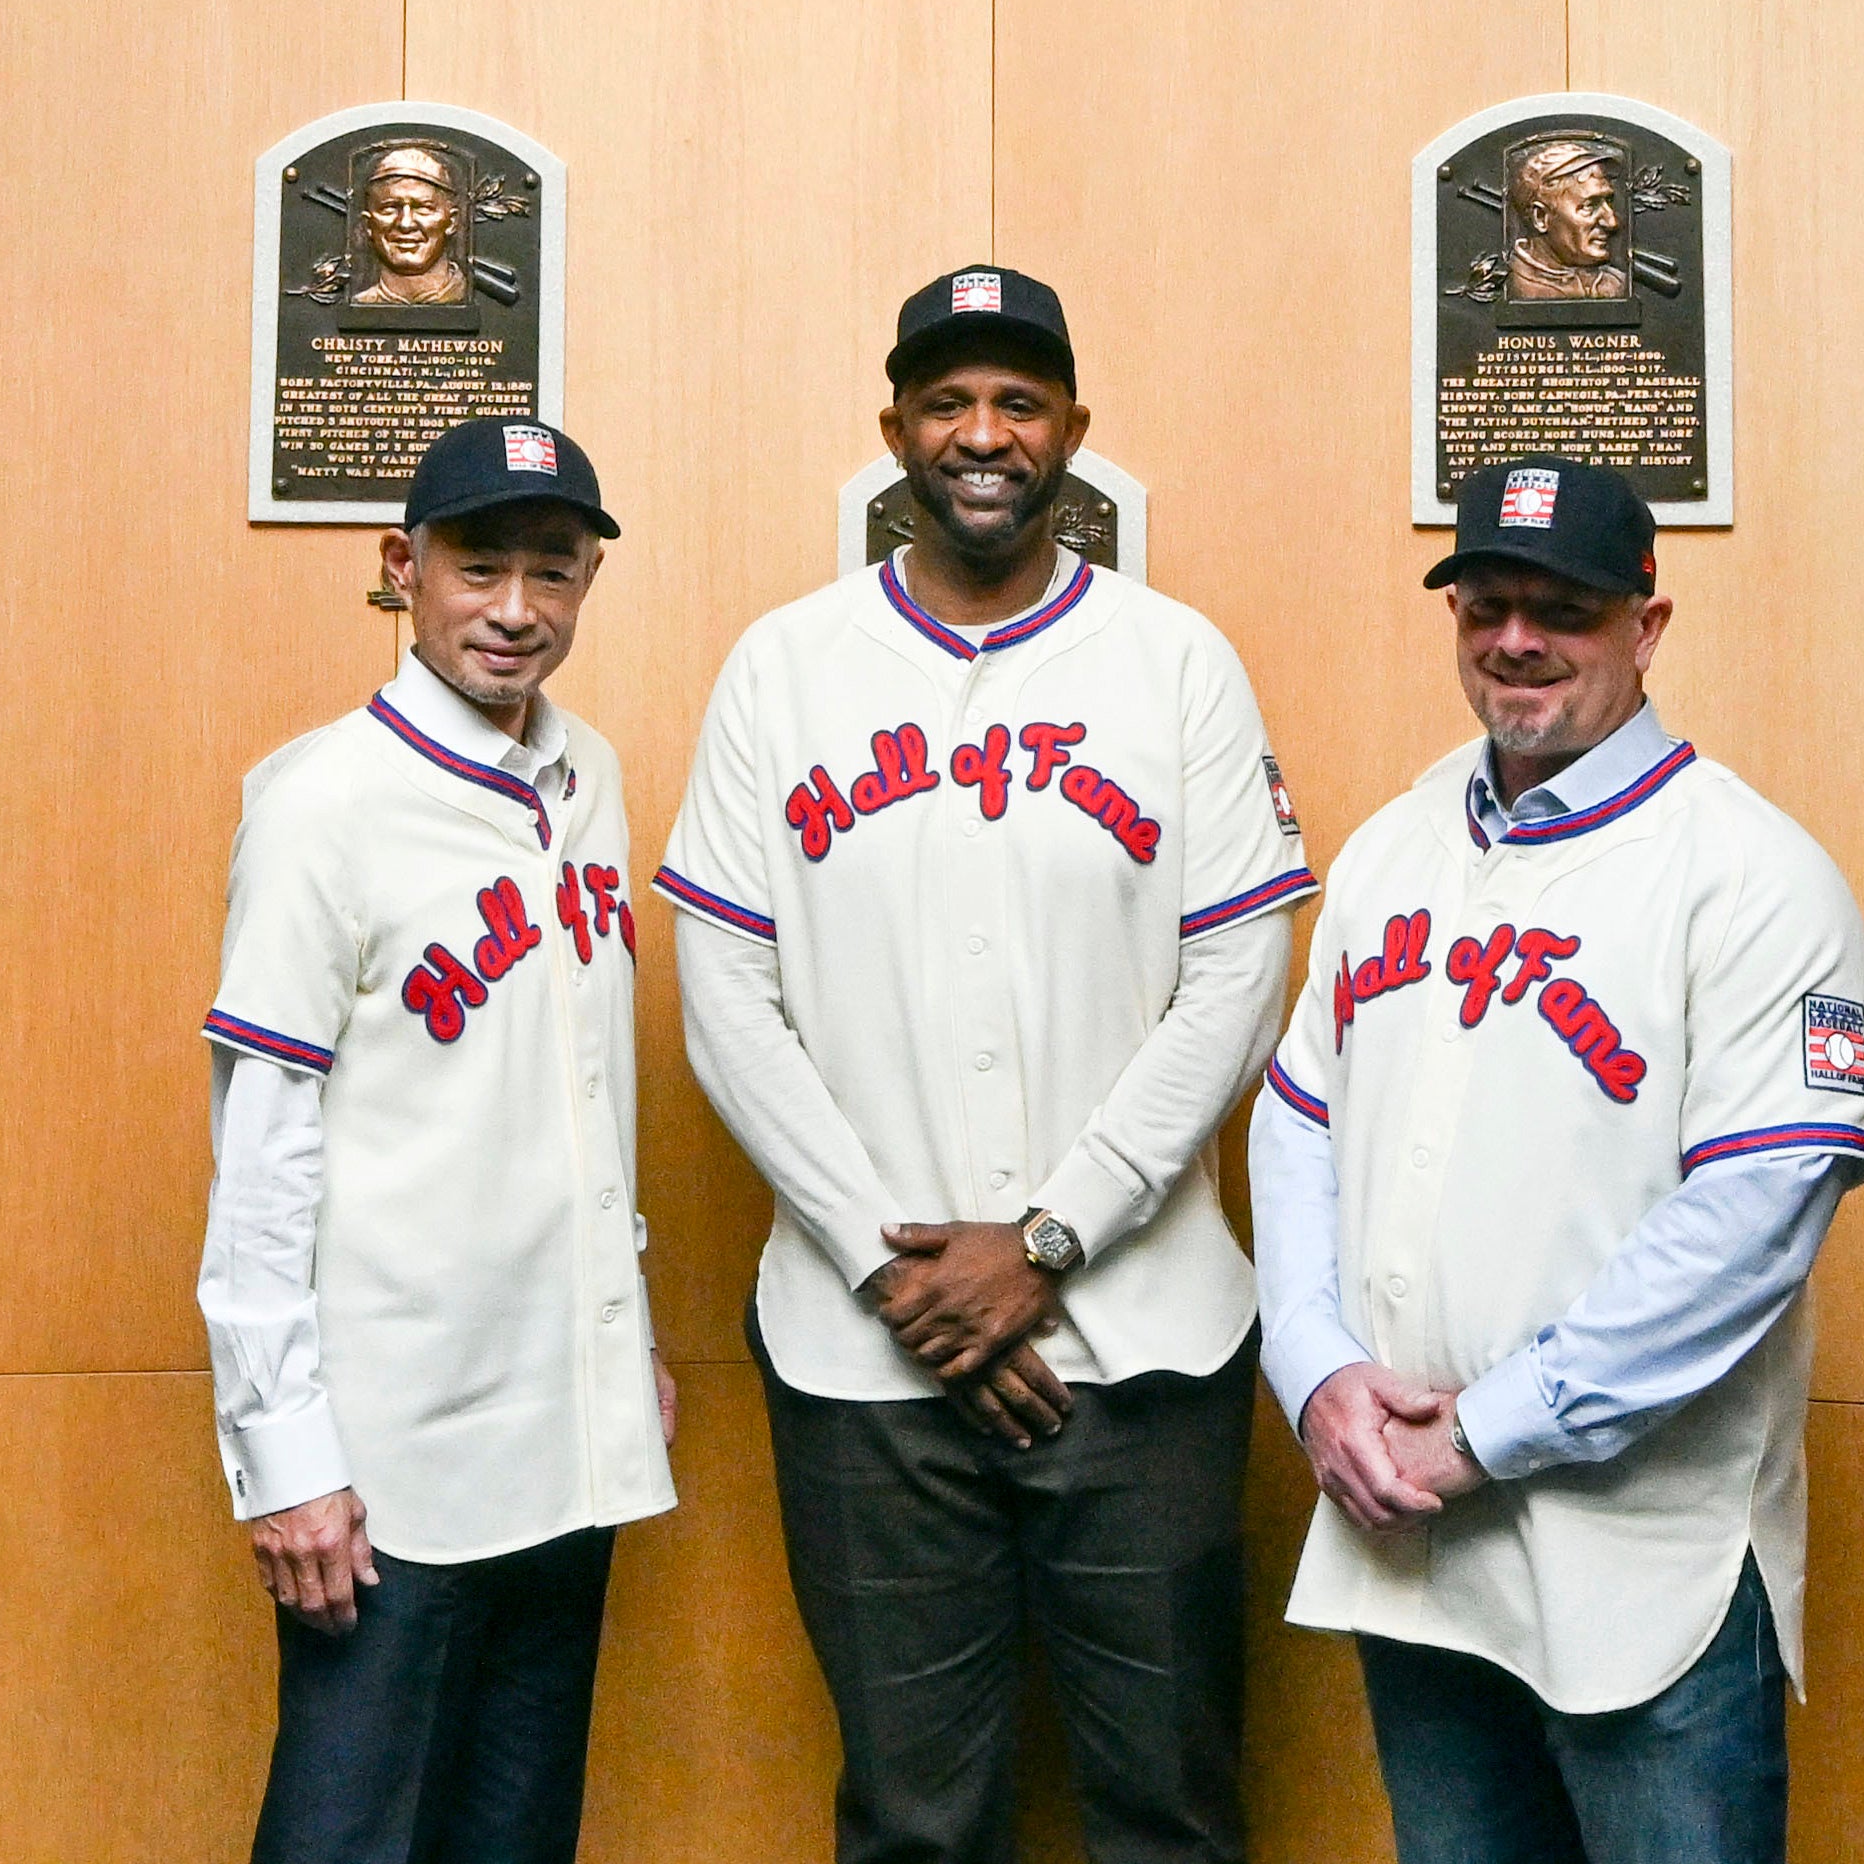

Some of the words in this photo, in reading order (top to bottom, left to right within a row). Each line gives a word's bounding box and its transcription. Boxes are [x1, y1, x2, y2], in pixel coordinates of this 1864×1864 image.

[311, 337, 386, 351] CHRISTY
[397, 338, 504, 353] MATHEWSON
[1498, 336, 1556, 349] HONUS
[1569, 335, 1641, 348] WAGNER
[324, 354, 353, 363] NEW
[360, 354, 398, 365] YORK,
[1478, 352, 1569, 362] LOUISVILLE,
[1477, 365, 1569, 374] PITTSBURGH,
[280, 377, 313, 387] BORN
[440, 381, 487, 390] AUGUST
[1441, 378, 1466, 387] THE
[1472, 377, 1535, 387] GREATEST
[1541, 377, 1610, 387] SHORTSTOP
[1616, 377, 1629, 386] IN
[1636, 376, 1701, 386] BASEBALL
[281, 390, 344, 400] GREATEST
[348, 392, 363, 401] OF
[366, 392, 392, 401] ALL
[396, 392, 419, 402] THE
[423, 393, 460, 402] GREAT
[467, 394, 528, 403] PITCHERS
[1504, 391, 1535, 400] BORN
[279, 403, 293, 412] IN
[299, 404, 323, 413] THE
[328, 404, 358, 413] 20TH
[433, 406, 469, 415] FIRST
[475, 406, 531, 416] QUARTER
[1441, 404, 1487, 413] KNOWN
[1491, 404, 1507, 413] TO
[1511, 404, 1543, 413] FAME
[1666, 403, 1694, 412] AND
[274, 416, 325, 425] PITCHED
[339, 417, 399, 426] SHUTOUTS
[403, 418, 415, 427] IN
[1473, 417, 1517, 426] FLYING
[1594, 416, 1648, 426] RETIRED
[1654, 416, 1667, 426] IN
[278, 428, 313, 437] FIRST
[319, 429, 370, 438] PITCHER
[374, 429, 390, 438] OF
[394, 430, 416, 439] THE
[1440, 430, 1486, 440] HAVING
[1493, 430, 1539, 440] SCORED
[1544, 430, 1576, 439] MORE
[1659, 429, 1693, 438] MORE
[280, 441, 304, 450] WIN
[329, 442, 370, 451] GAMES
[375, 442, 388, 451] IN
[1445, 443, 1475, 453] HITS
[1480, 443, 1506, 452] AND
[1510, 443, 1556, 452] STOLEN
[1560, 443, 1592, 452] MORE
[1598, 443, 1639, 452] BASES
[1648, 442, 1683, 452] THAN
[327, 454, 354, 463] WON
[361, 455, 376, 464] 37
[1448, 457, 1475, 466] ANY
[1589, 456, 1603, 465] IN
[1609, 456, 1633, 465] THE
[1640, 456, 1693, 465] HISTORY
[345, 468, 371, 477] WAS
[1450, 471, 1465, 479] OF
[785, 722, 940, 863] Hall
[950, 724, 1013, 821] of
[1020, 721, 1161, 865] Fame
[402, 876, 542, 1043] Hall
[1446, 923, 1516, 1029] of
[1502, 928, 1647, 1104] Fame
[1809, 999, 1863, 1018] NATIONAL
[1811, 1070, 1835, 1080] HALL
